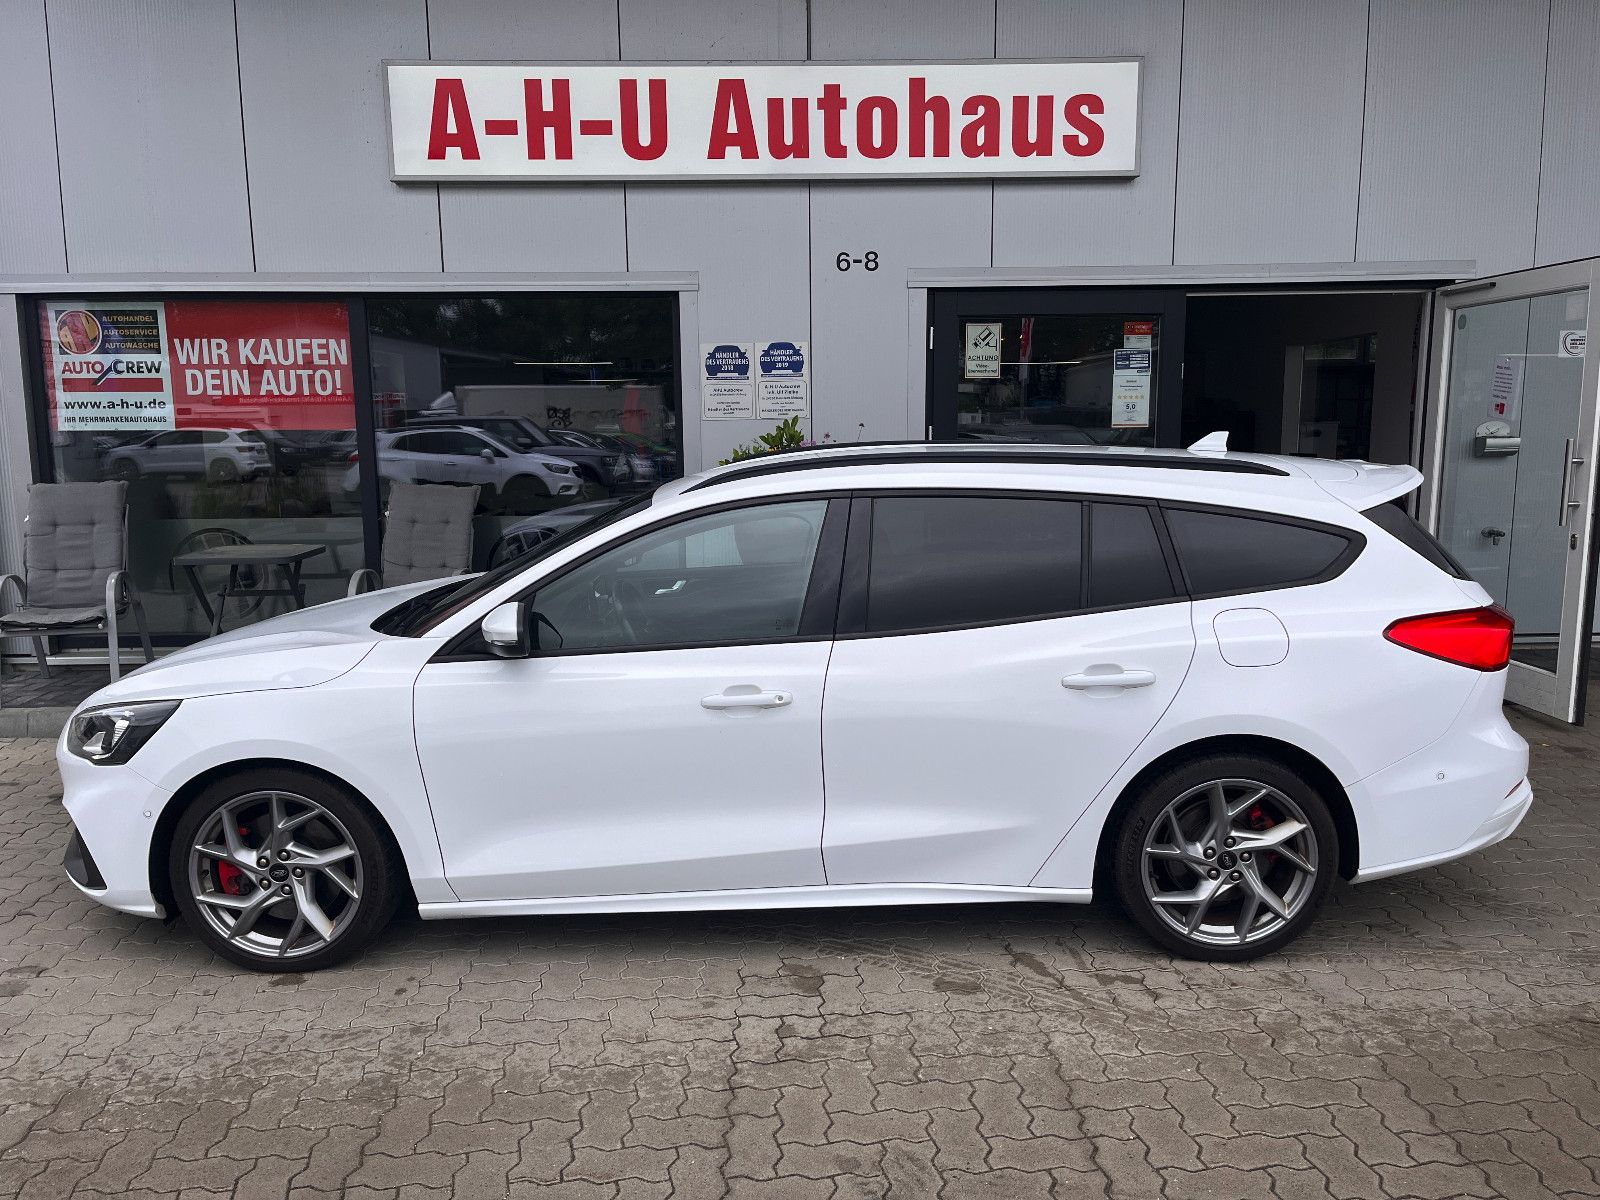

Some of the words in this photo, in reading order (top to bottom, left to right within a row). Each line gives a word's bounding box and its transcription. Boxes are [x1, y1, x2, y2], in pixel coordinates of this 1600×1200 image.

[427, 78, 669, 161] A-H-U
[707, 76, 1105, 161] Autohaus
[836, 250, 879, 272] 6-8
[173, 338, 231, 366] WIR
[238, 338, 349, 366] KAUFEN
[184, 368, 252, 396] DEIN
[259, 368, 343, 396] AUTO!
[64, 398, 167, 410] www.a-h-u.de
[1125, 403, 1136, 411] 5,0
